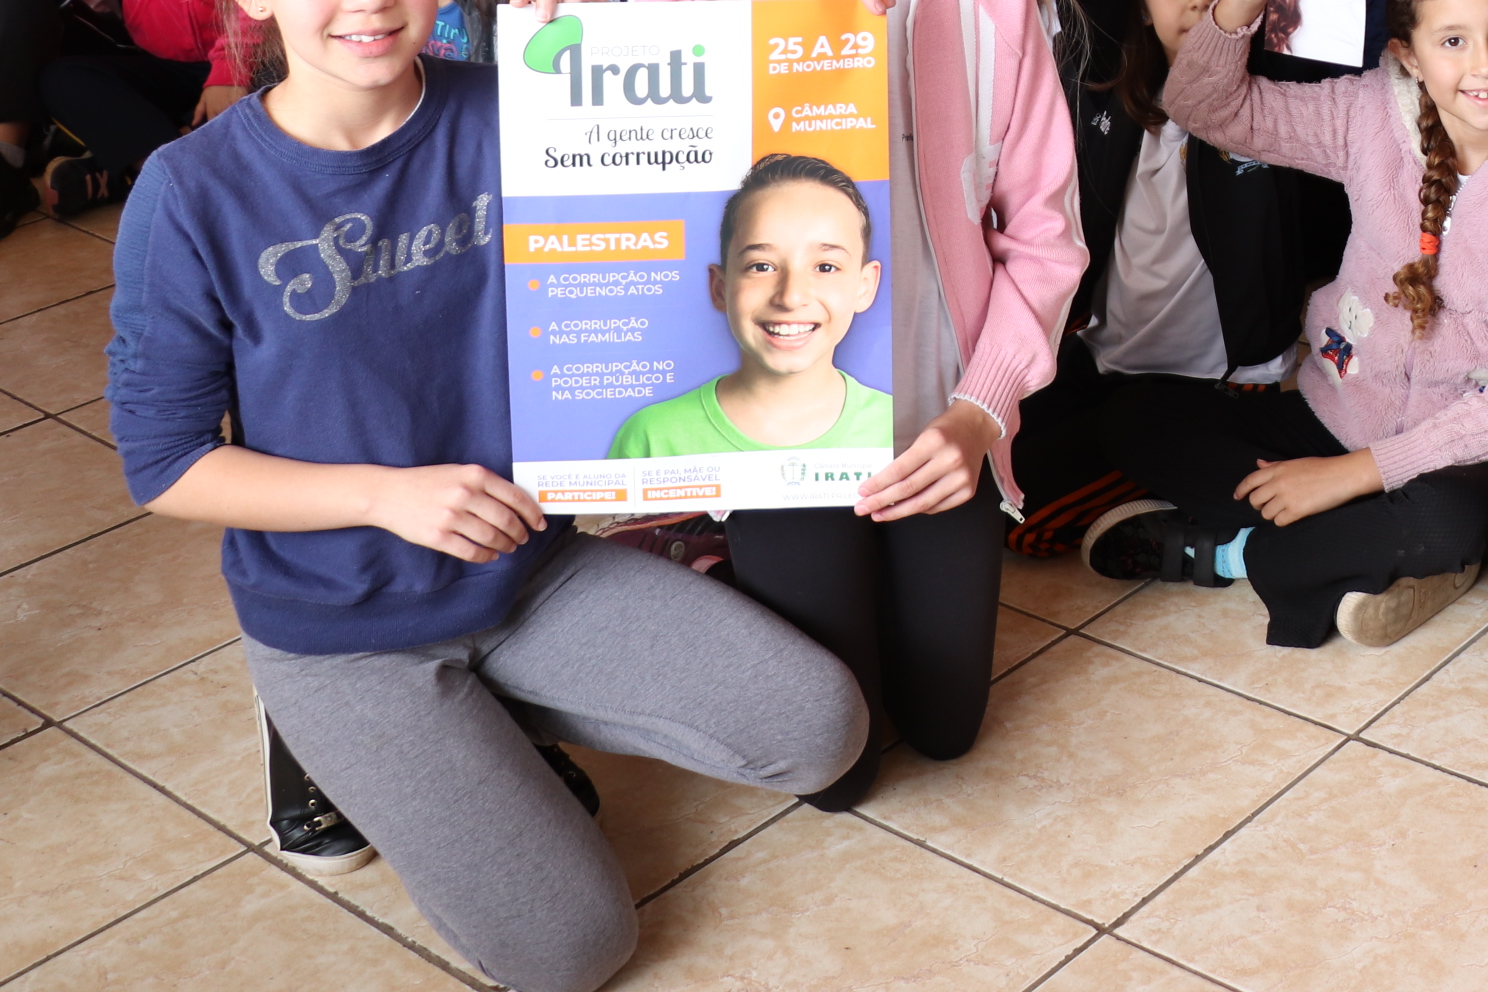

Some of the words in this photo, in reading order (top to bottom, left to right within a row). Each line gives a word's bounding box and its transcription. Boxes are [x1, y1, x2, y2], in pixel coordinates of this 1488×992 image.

[591, 45, 660, 57] PROJETO
[768, 37, 804, 60] 25
[810, 35, 833, 58] A
[840, 31, 875, 56] 29
[769, 62, 789, 74] DE
[793, 56, 876, 73] NOVEMBRO
[552, 43, 713, 107] Irati
[791, 103, 858, 118] CÂMARA
[791, 117, 876, 132] MUNICIPAL
[585, 124, 600, 145] A
[607, 125, 655, 147] gente
[661, 126, 713, 141] cresce
[544, 146, 593, 169] Sem
[600, 145, 713, 171] corrupção
[528, 231, 669, 253] PALESTRAS
[257, 191, 493, 321] Sweet
[547, 274, 557, 285] A
[560, 270, 647, 285] CORRUPÇÃO
[651, 270, 680, 282] NOS
[548, 285, 625, 299] PEQUENOS
[627, 284, 663, 295] ATOS
[549, 321, 559, 332] A
[561, 317, 649, 332] CORRUPÇÃO
[550, 333, 578, 345] NAS
[581, 330, 642, 343] FAMÍLIAS
[551, 364, 561, 375] A
[563, 360, 650, 375] CORRUPÇÃO
[653, 360, 674, 371] NO
[551, 376, 600, 388] PODER
[603, 373, 663, 386] PÚBLICO
[666, 372, 675, 383] E
[552, 390, 572, 401] NA
[575, 386, 654, 399] SOCIEDADE
[550, 473, 573, 481] VOCÊ
[664, 468, 682, 477] PAI,
[684, 466, 704, 475] MÃE
[814, 472, 872, 482] IRATI
[537, 480, 566, 488] REDE
[569, 479, 627, 488] MUNICIPAL
[642, 473, 721, 486] RESPONSÁVEL
[547, 491, 616, 501] PARTICIPE!
[647, 486, 716, 499] INCENTIVE!
